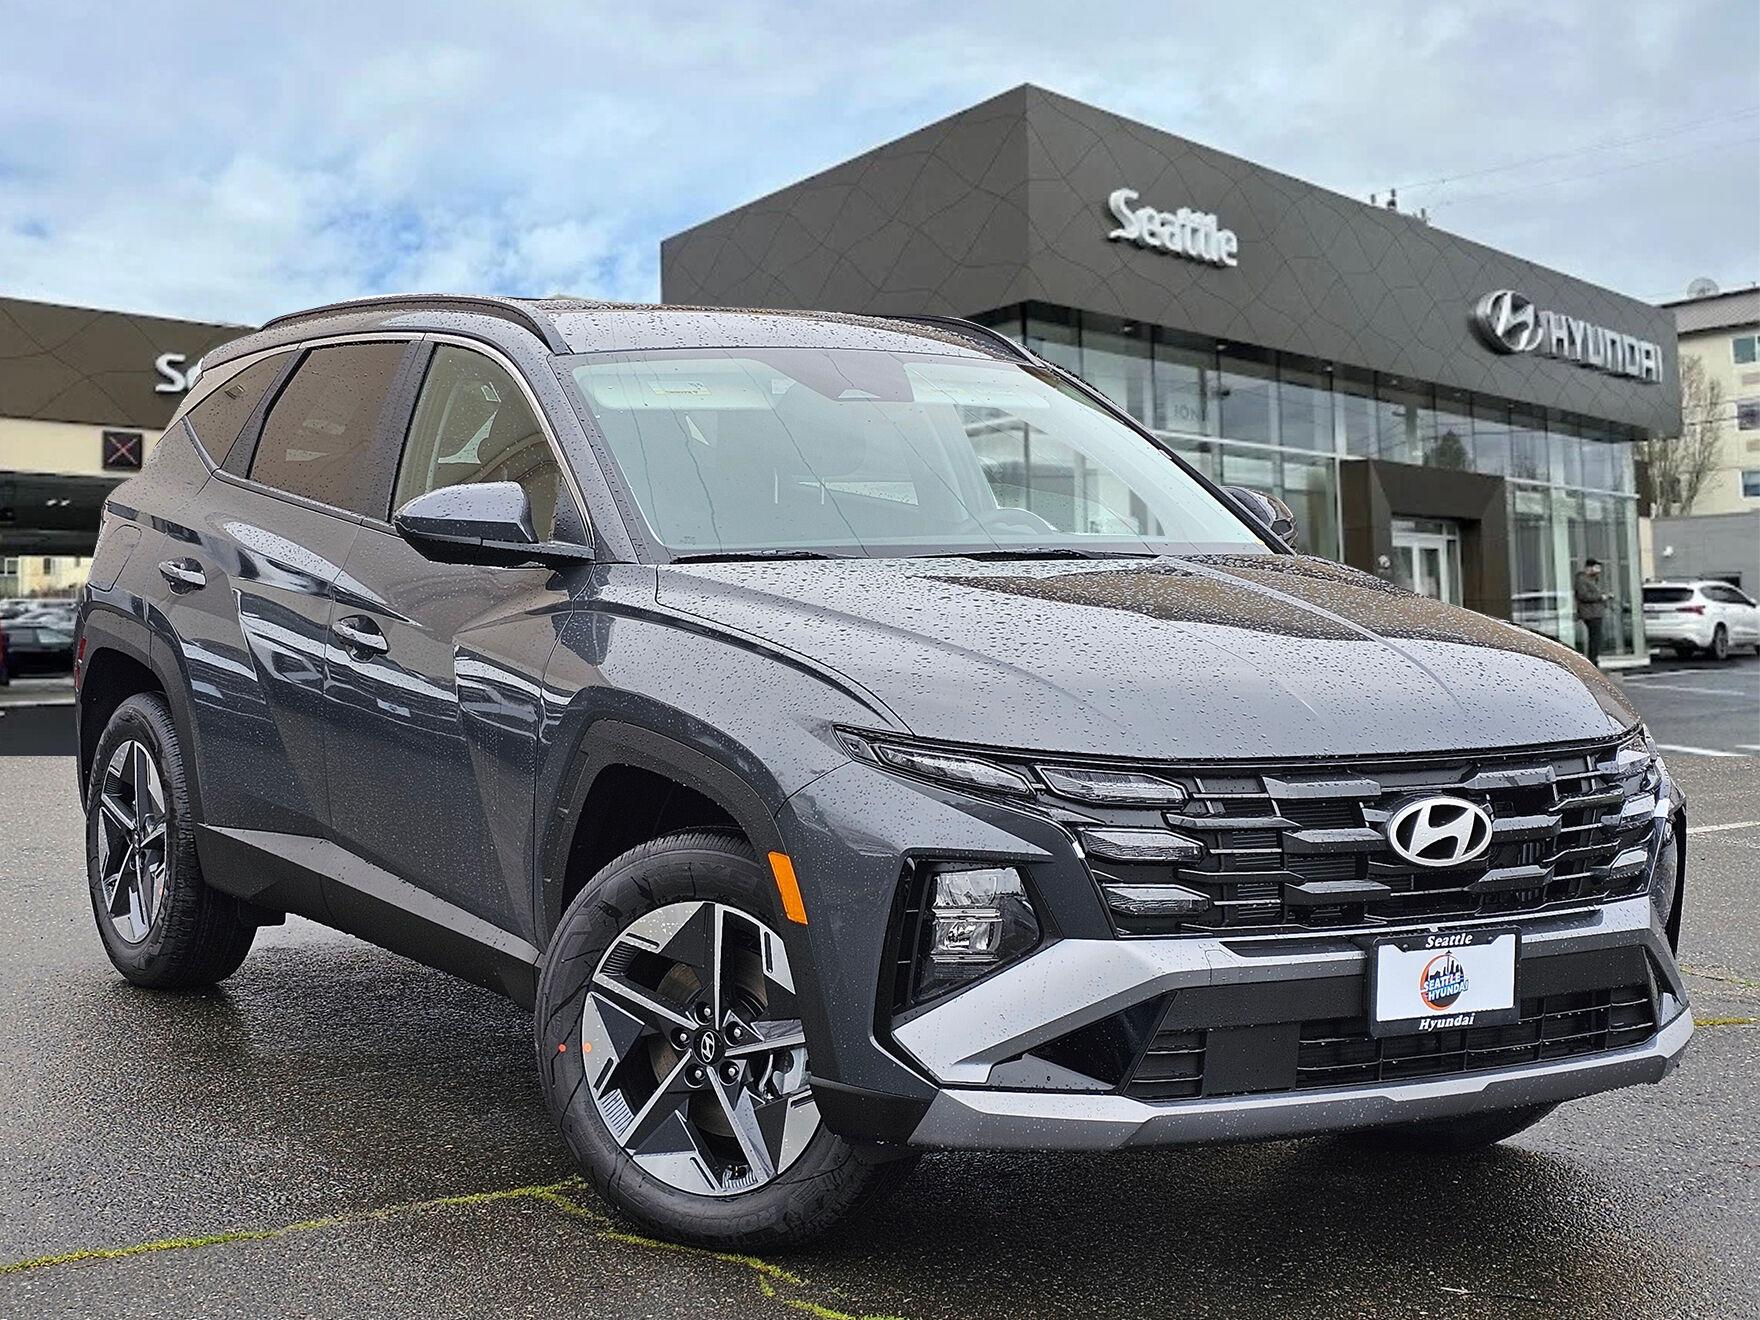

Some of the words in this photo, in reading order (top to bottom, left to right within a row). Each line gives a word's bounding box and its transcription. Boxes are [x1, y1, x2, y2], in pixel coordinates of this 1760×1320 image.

[1108, 187, 1238, 267] Seattle
[1540, 311, 1663, 382] HYUNDAI
[1425, 933, 1473, 948] Seattle
[1423, 973, 1462, 992] SEATTLE
[1428, 979, 1469, 1001] HYUNDAI
[1419, 1014, 1475, 1031] Hyundai
